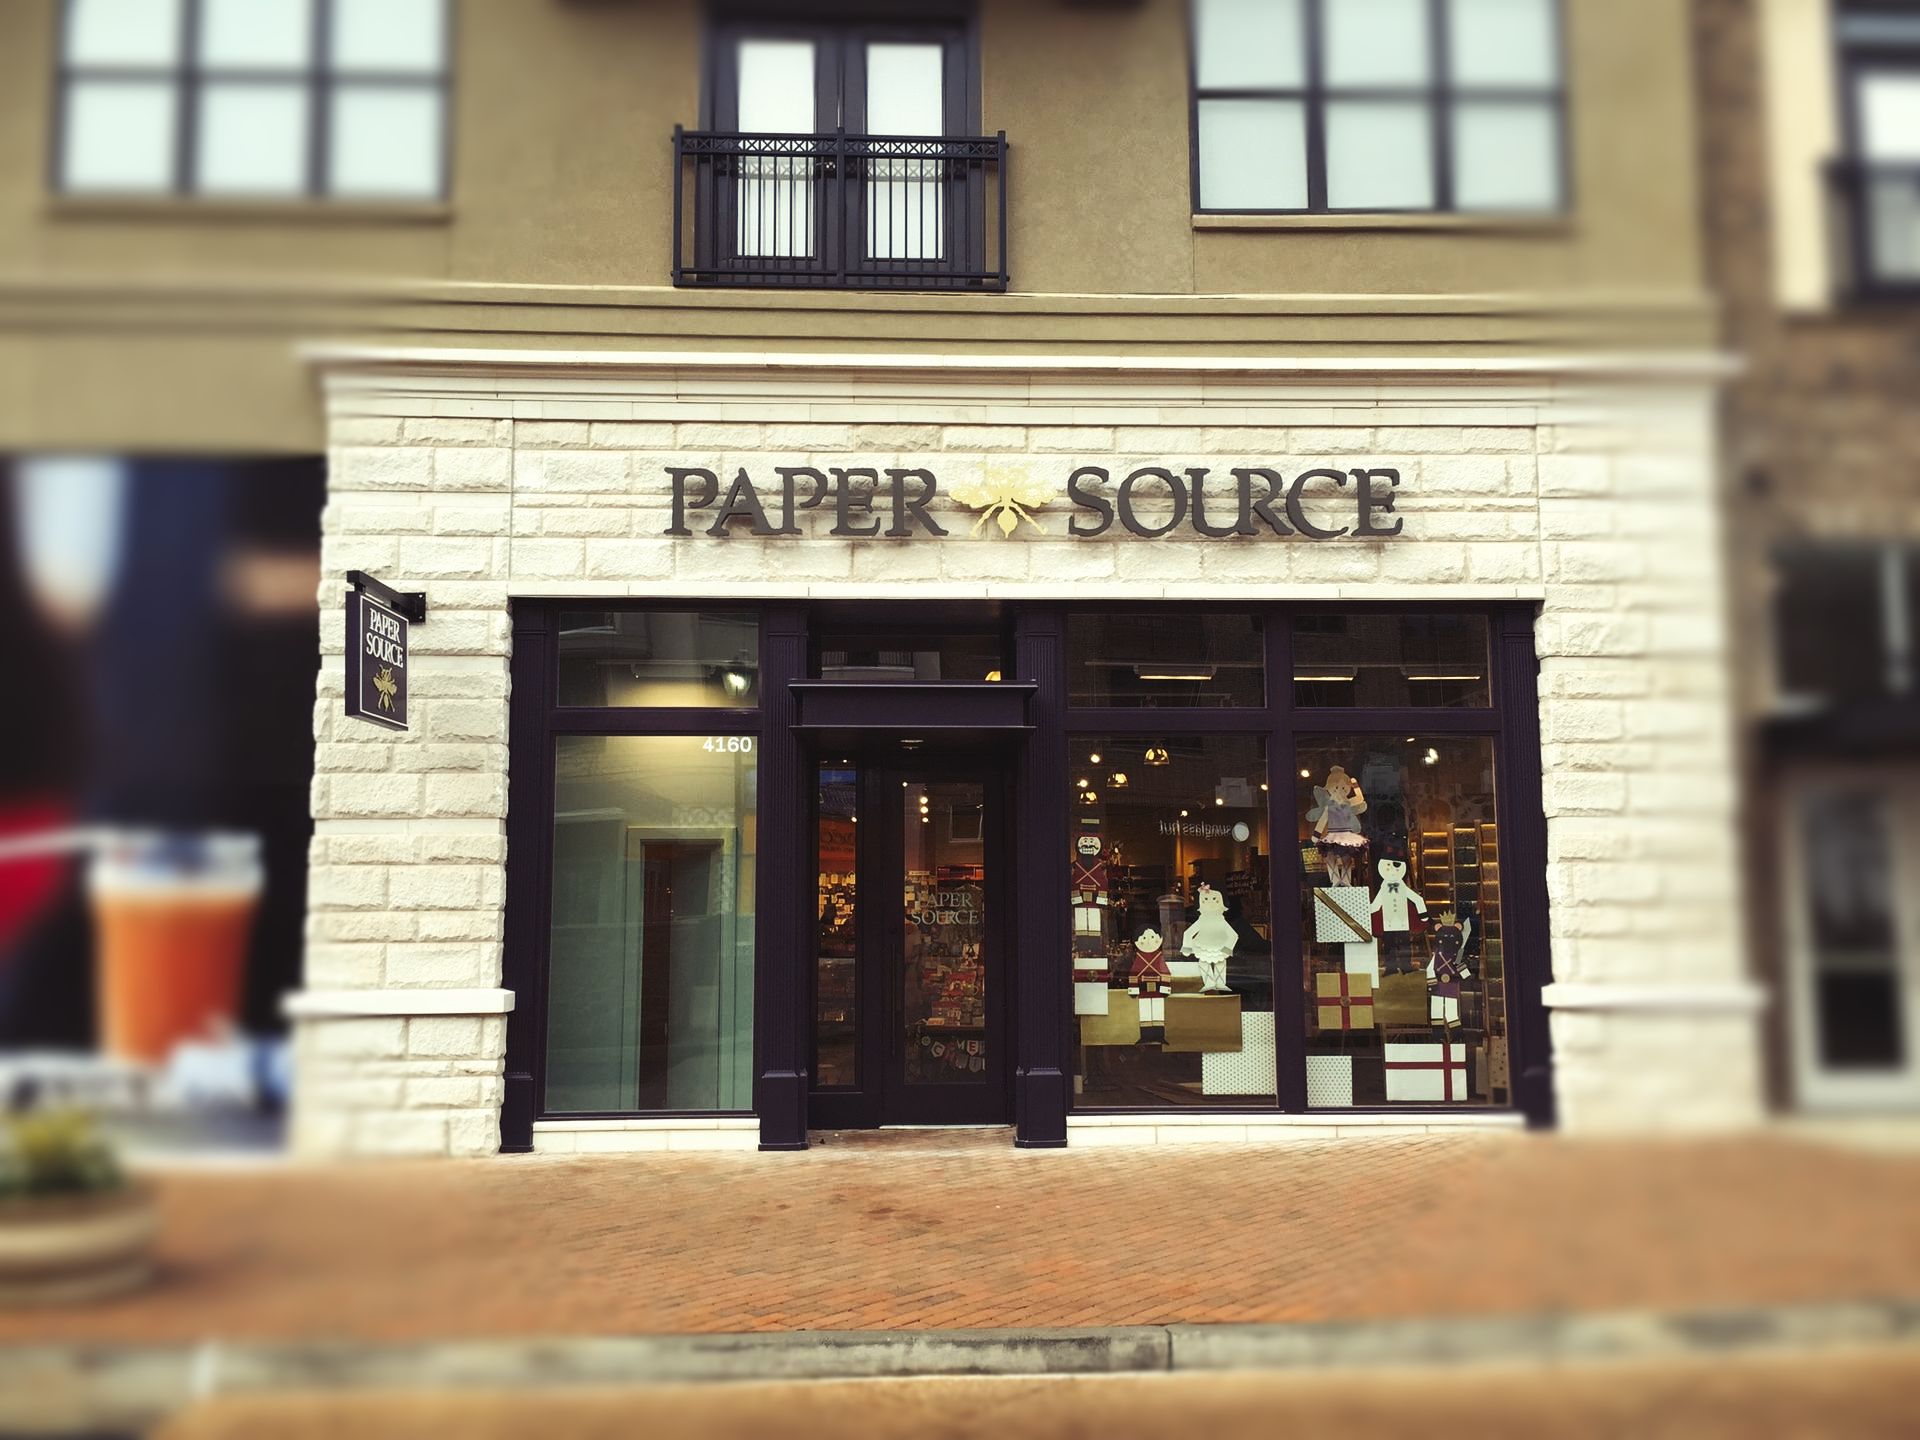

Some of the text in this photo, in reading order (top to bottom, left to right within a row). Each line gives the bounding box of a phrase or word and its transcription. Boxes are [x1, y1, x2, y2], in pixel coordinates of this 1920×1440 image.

[664, 466, 1404, 539] PAPER SOURCE
[369, 608, 400, 643] PAPER
[366, 632, 403, 668] SOURCE
[702, 736, 752, 753] 4160
[911, 909, 979, 925] SOURCE
